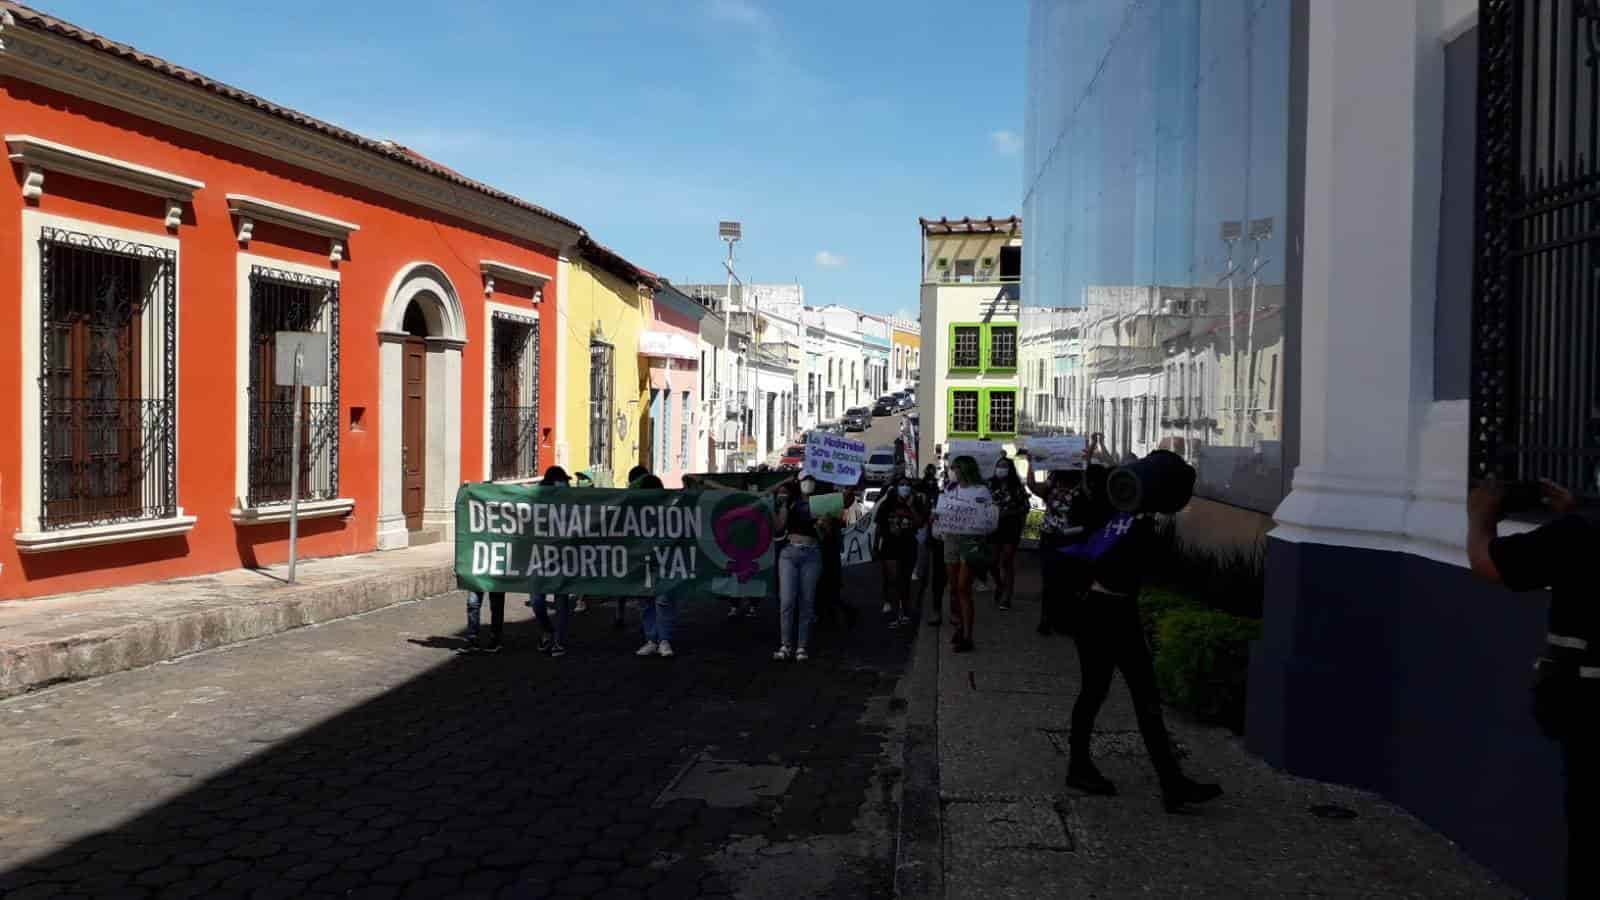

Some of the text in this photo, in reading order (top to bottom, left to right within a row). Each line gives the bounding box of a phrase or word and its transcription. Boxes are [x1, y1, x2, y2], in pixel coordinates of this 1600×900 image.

[468, 497, 702, 539] DESPENALIZACIÓN
[472, 541, 697, 588] DEL ABORTO ¡YA!
